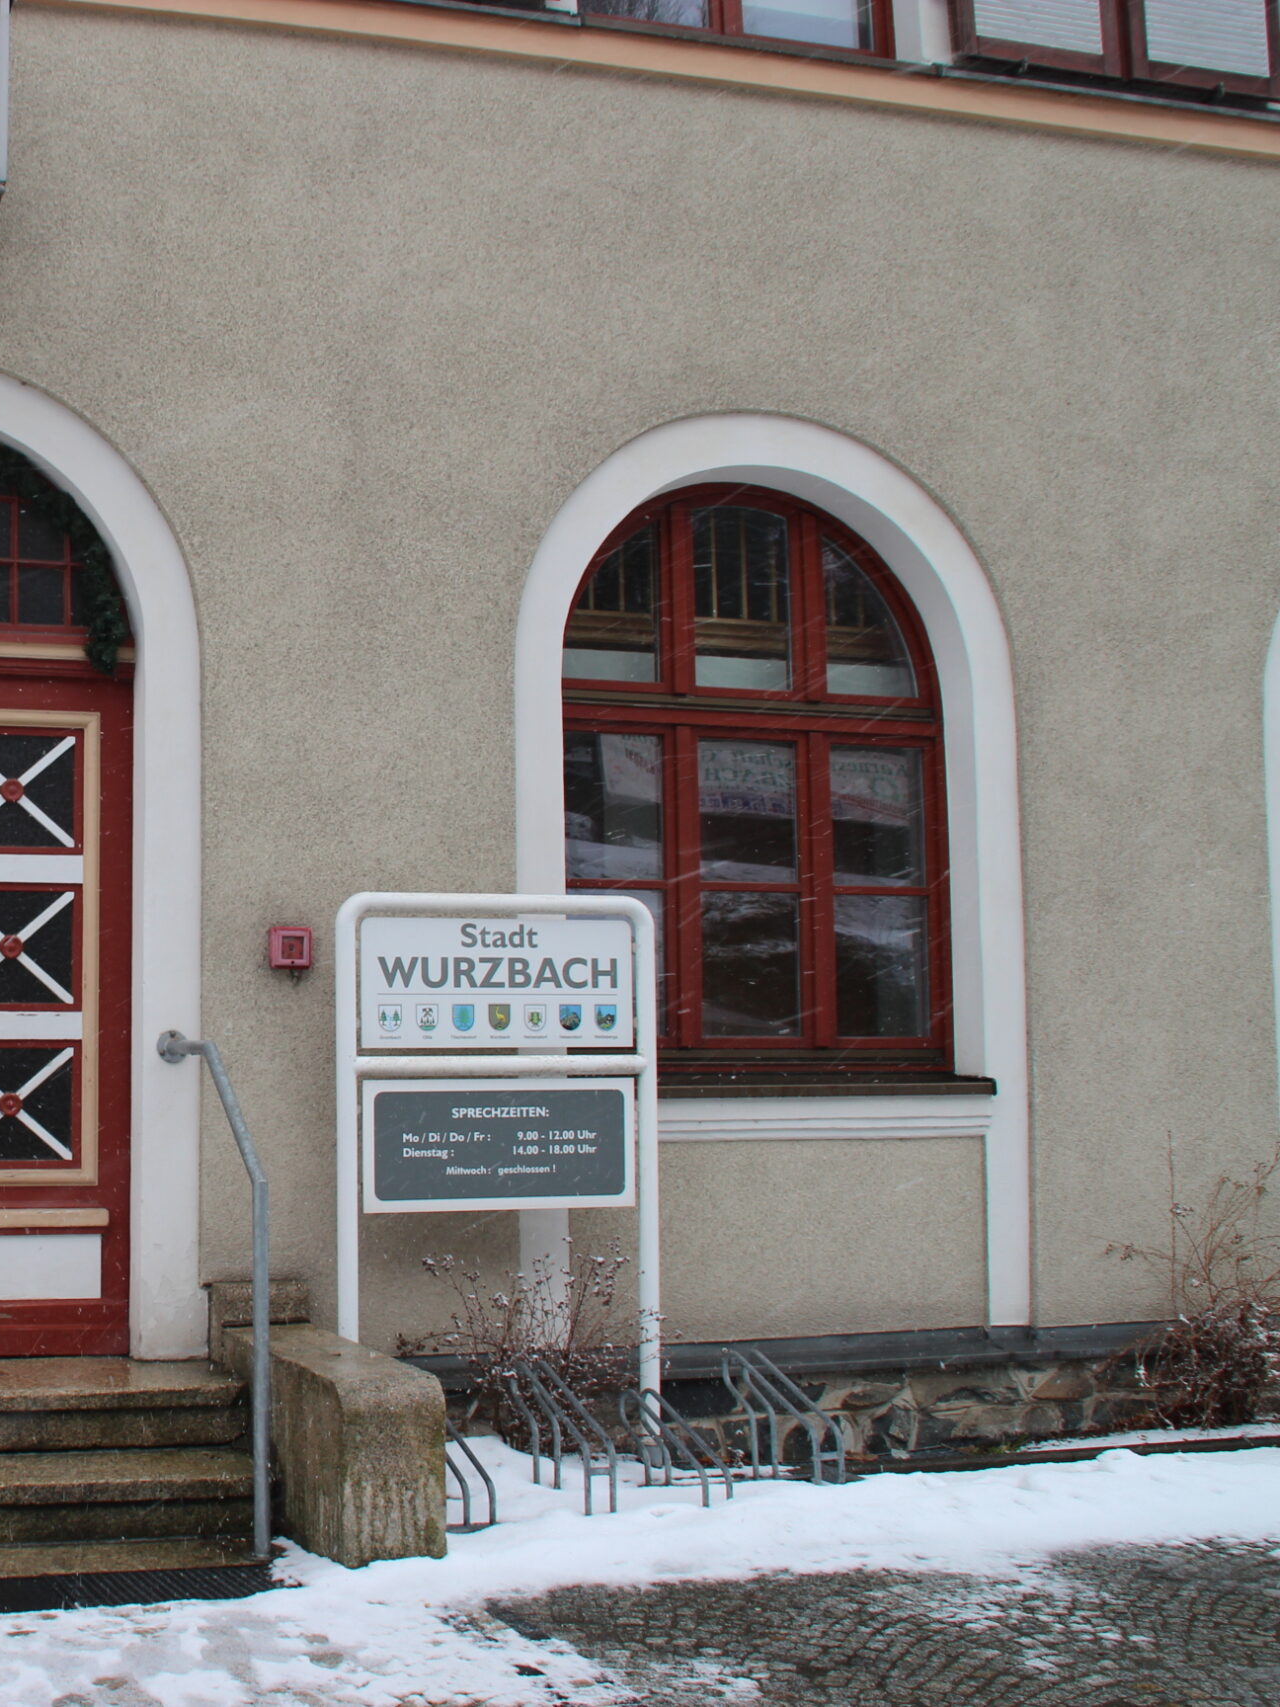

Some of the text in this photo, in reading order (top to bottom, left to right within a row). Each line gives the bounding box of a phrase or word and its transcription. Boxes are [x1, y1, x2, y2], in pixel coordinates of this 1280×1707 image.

[460, 923, 538, 949] Stadt
[377, 956, 618, 989] WURZBACH
[451, 1106, 550, 1119] SPRECHZEITEN:
[402, 1133, 420, 1143] Mo
[428, 1132, 440, 1143] Di
[449, 1132, 465, 1142] Do
[517, 1131, 539, 1141] 9.00
[549, 1130, 575, 1140] 12.00
[577, 1129, 597, 1140] Uhr
[403, 1147, 449, 1159] Dienstag
[512, 1145, 539, 1155] 14.00
[549, 1144, 575, 1155] 18.00
[577, 1144, 597, 1154] Uhr
[497, 1164, 550, 1176] geschlossen
